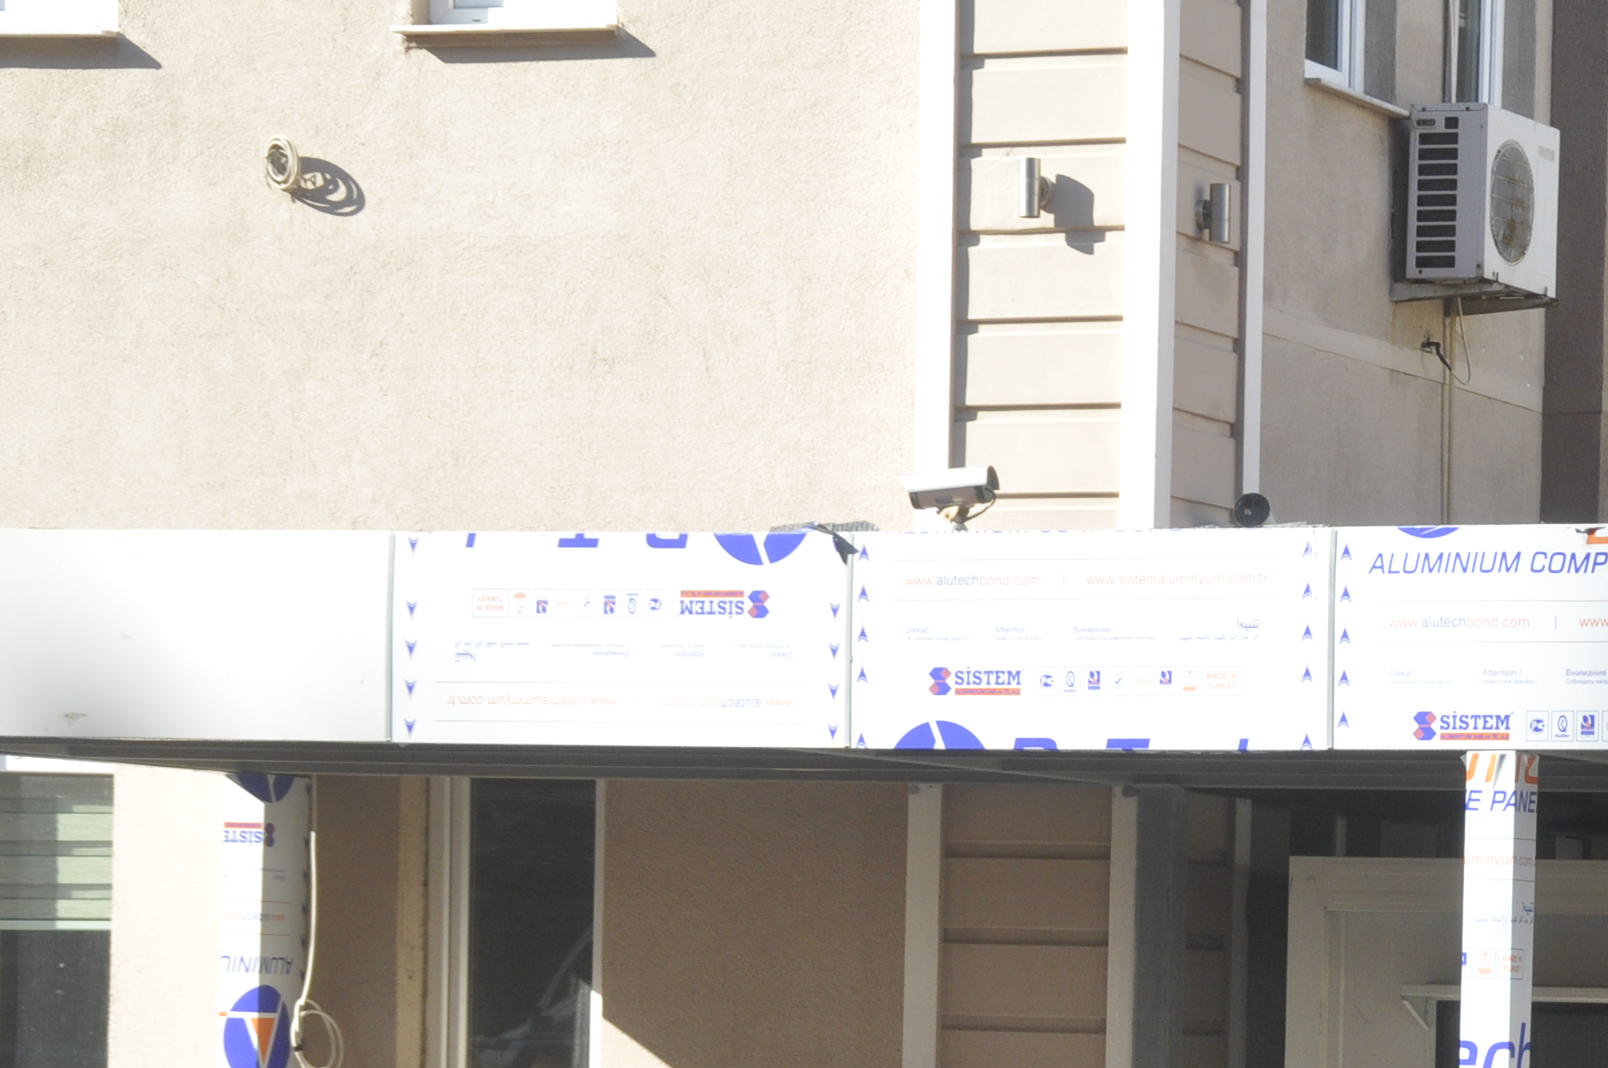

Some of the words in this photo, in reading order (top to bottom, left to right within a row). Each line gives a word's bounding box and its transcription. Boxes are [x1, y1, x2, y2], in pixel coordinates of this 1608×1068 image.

[1368, 551, 1521, 574] ALUMINIUM
[1440, 711, 1511, 731] SİSTEM
[1490, 789, 1537, 813] PANE
